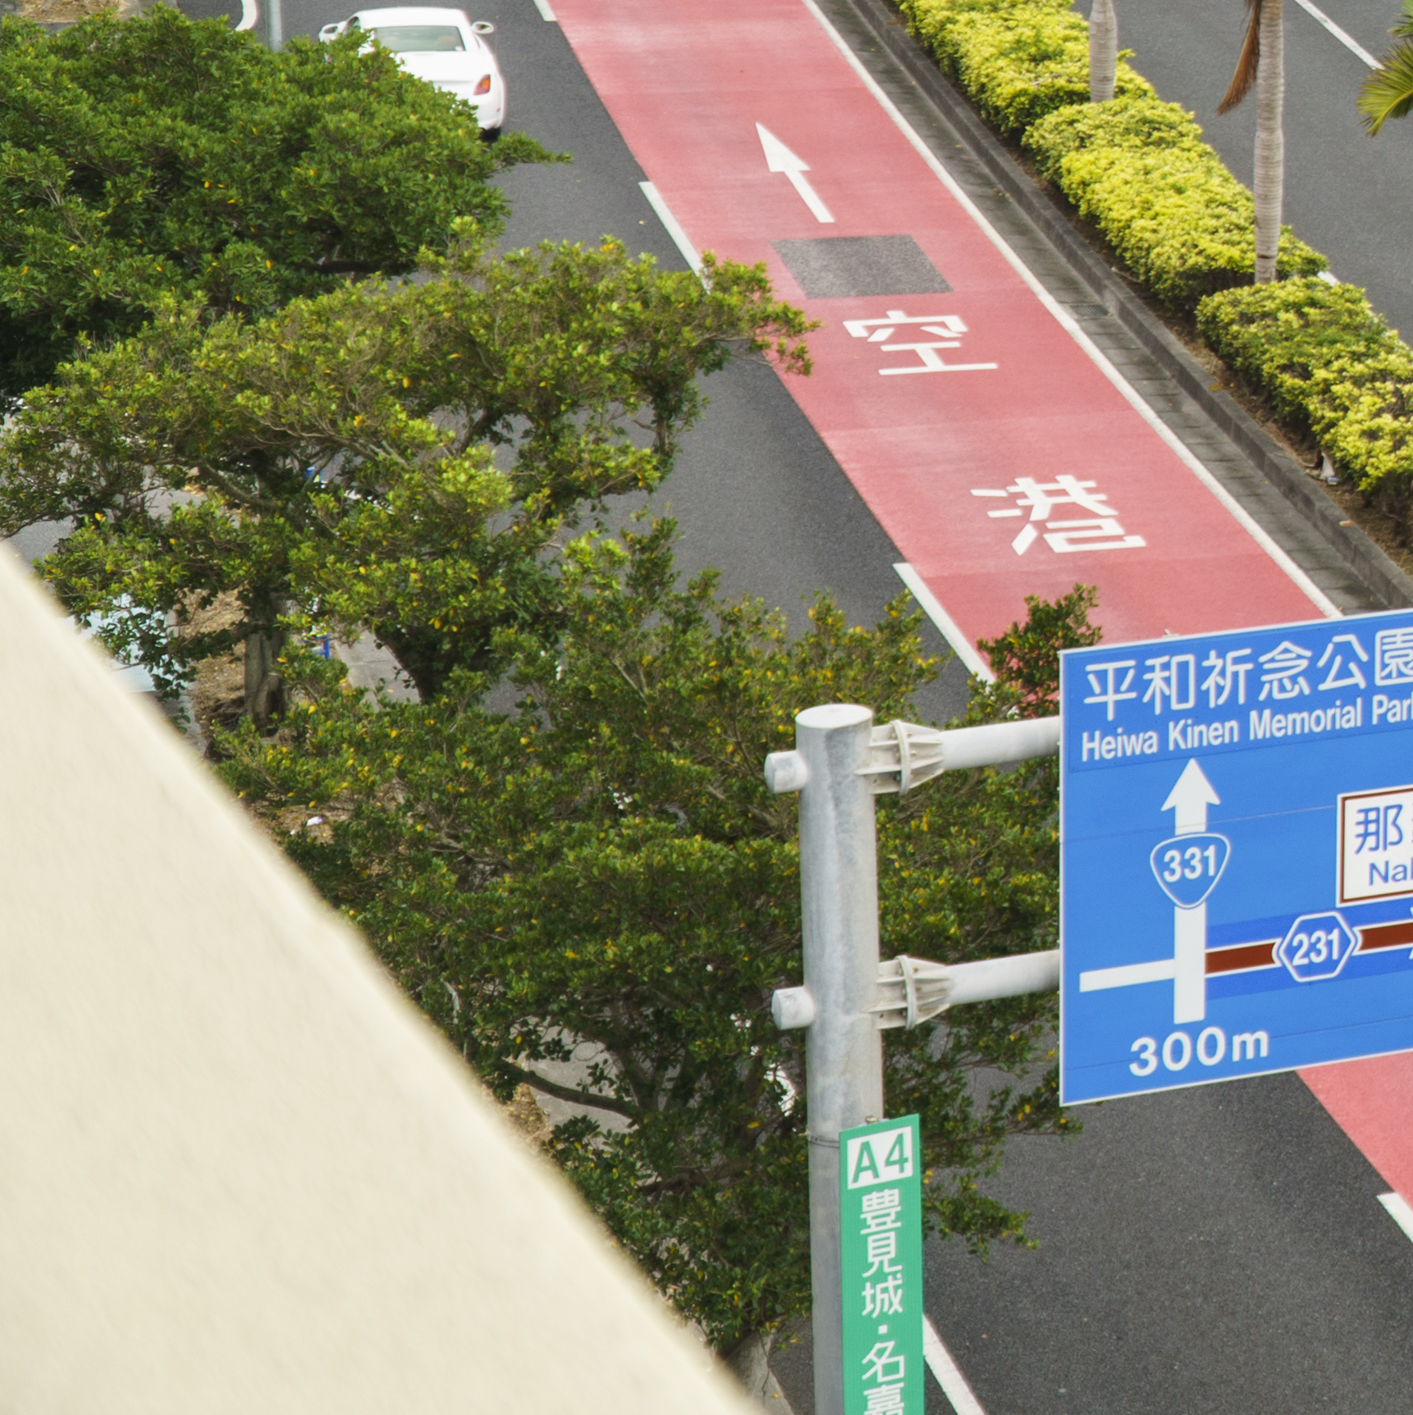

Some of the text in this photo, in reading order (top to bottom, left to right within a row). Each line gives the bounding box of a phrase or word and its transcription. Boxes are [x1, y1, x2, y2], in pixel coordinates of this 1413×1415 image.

[1081, 729, 1159, 762] Heiwa
[1167, 718, 1240, 751] Kinen
[1248, 697, 1363, 741] Memorial
[1161, 844, 1217, 884] 331
[1291, 928, 1341, 967] 231
[1128, 1026, 1270, 1078] 300m
[851, 1132, 910, 1185] A4
